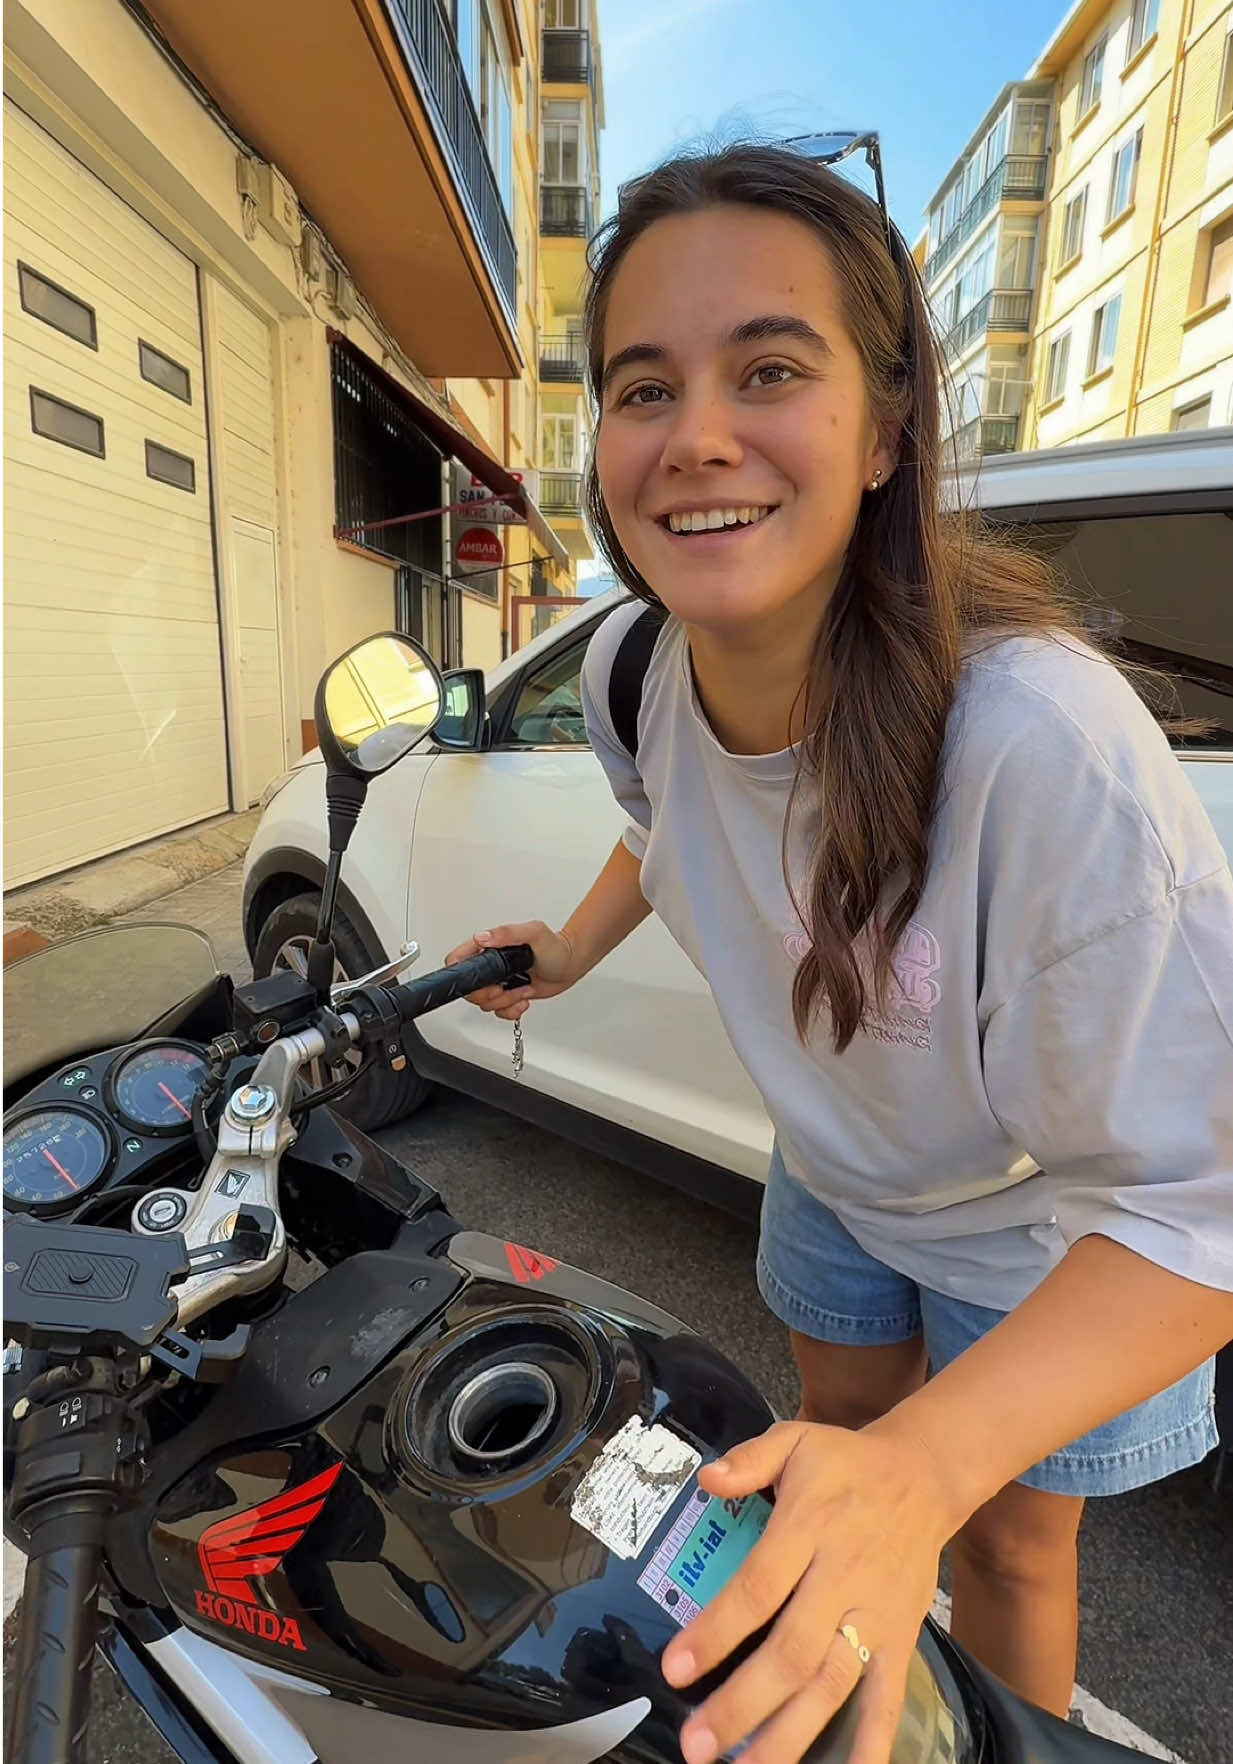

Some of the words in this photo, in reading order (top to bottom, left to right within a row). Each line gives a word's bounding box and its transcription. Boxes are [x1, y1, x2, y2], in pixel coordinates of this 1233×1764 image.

[459, 489, 485, 502] SAN
[459, 543, 497, 554] AMBAR
[678, 1519, 727, 1588] itv-iat
[194, 1589, 308, 1651] HONDA
